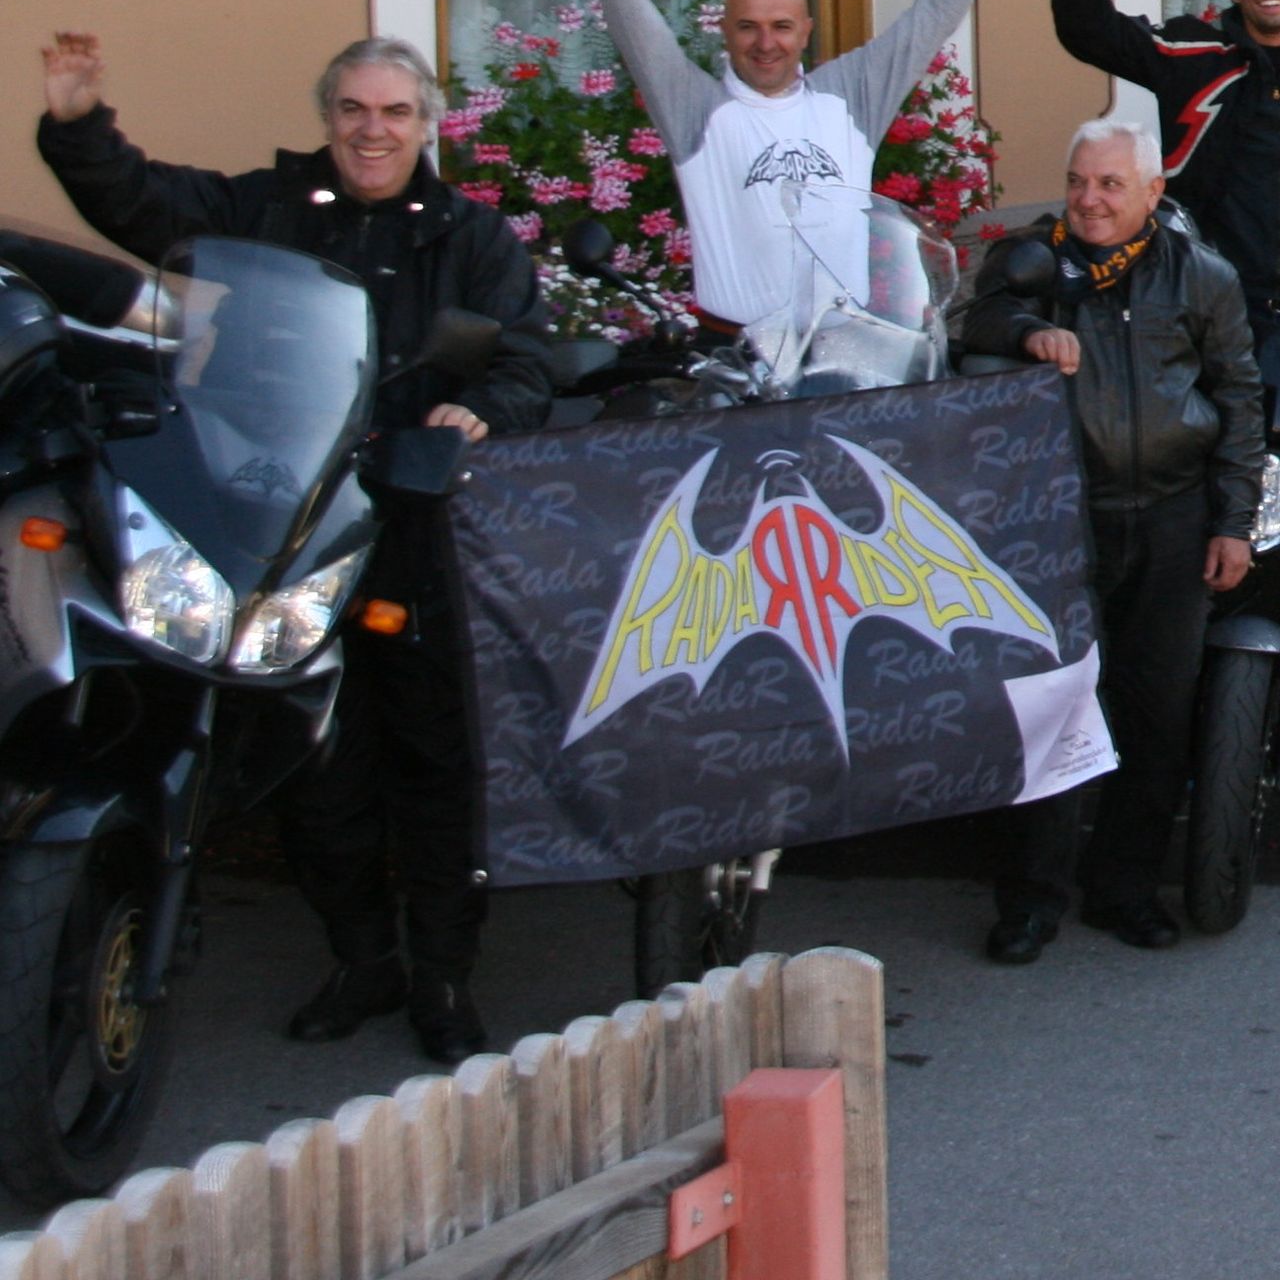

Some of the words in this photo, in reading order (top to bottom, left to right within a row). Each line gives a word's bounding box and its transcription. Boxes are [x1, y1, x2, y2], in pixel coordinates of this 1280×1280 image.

[637, 460, 753, 519] Rda
[956, 467, 1082, 536] RideR
[645, 656, 789, 728] RideR
[693, 721, 817, 785] Rada
[830, 688, 967, 758] RideR
[893, 753, 1001, 815] Rada
[654, 784, 812, 860] RideR
